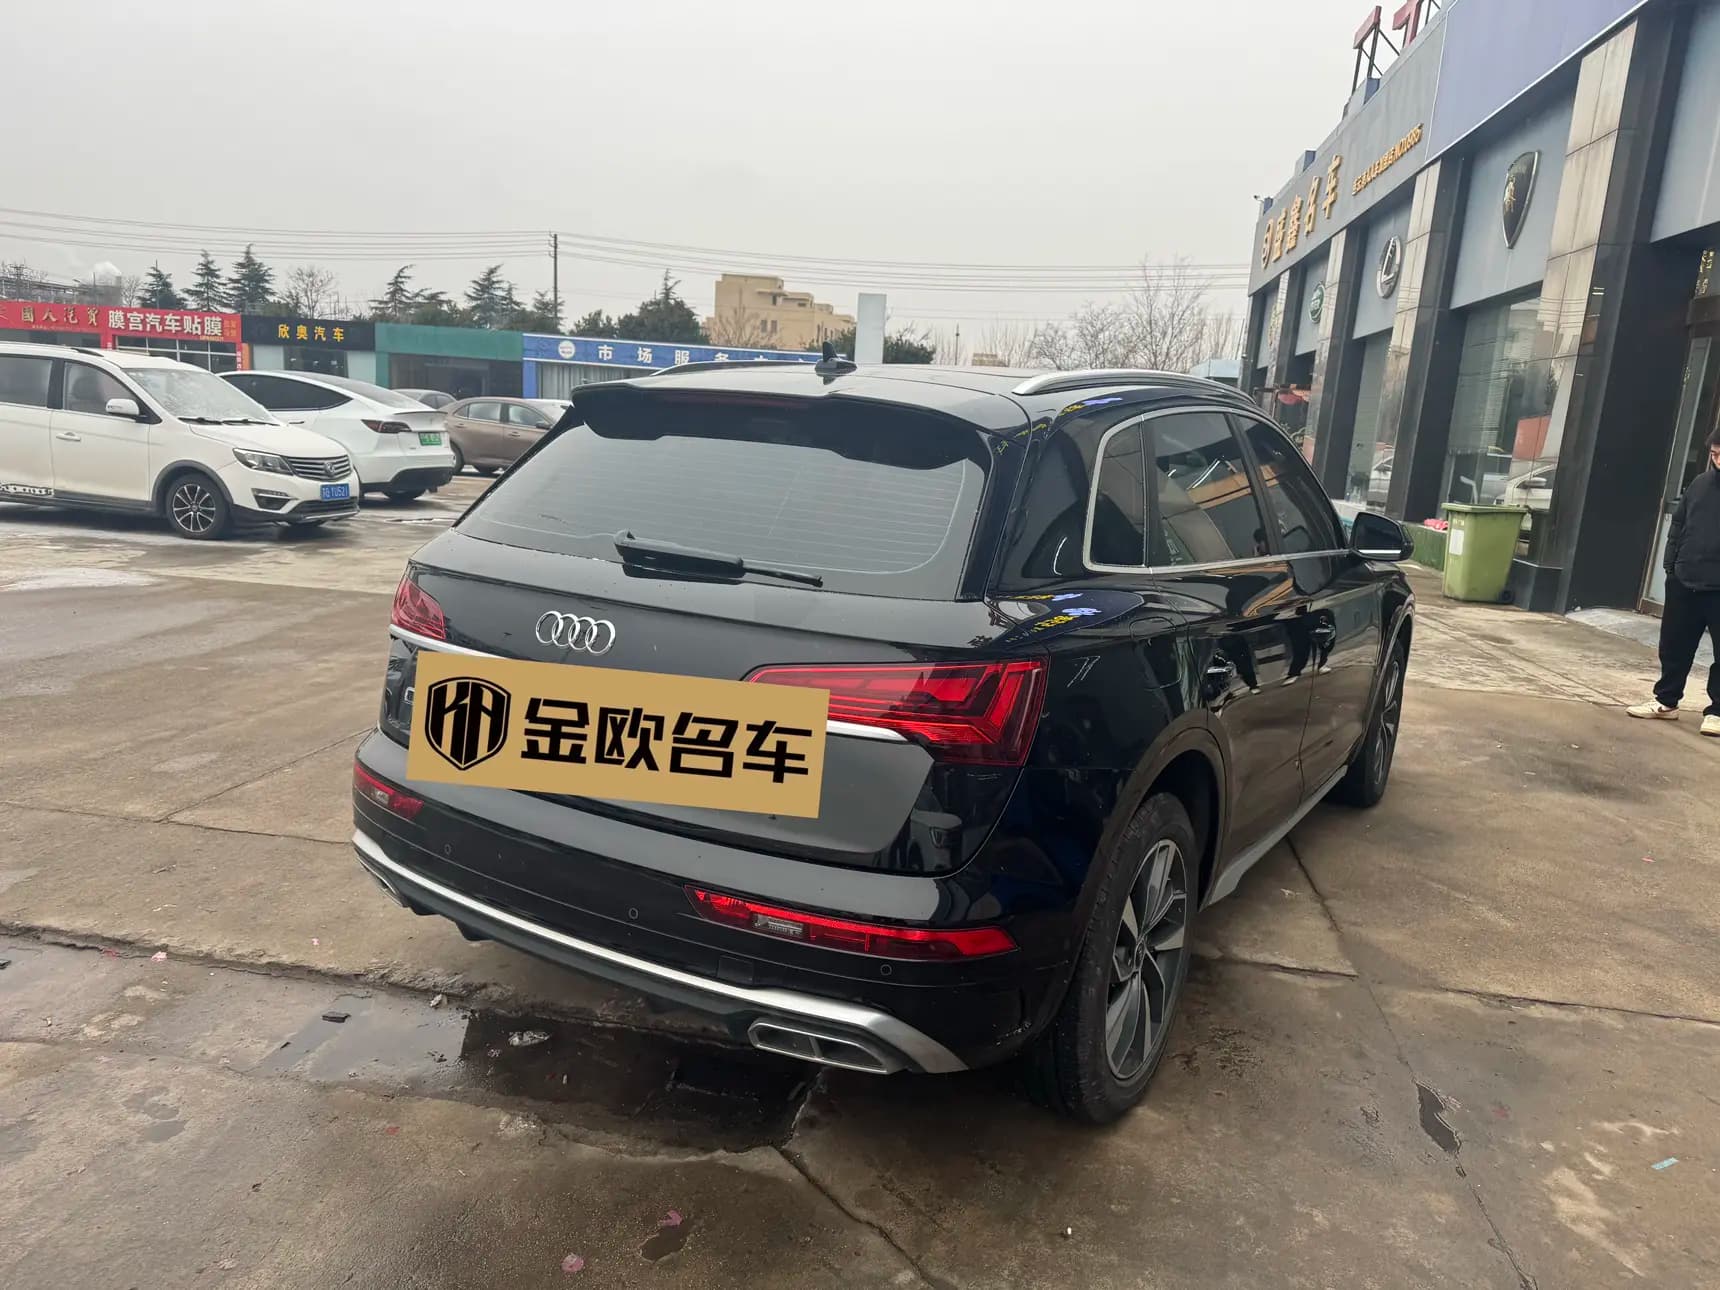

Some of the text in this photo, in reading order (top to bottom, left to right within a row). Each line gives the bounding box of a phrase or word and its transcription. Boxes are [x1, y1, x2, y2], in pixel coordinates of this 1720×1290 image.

[108, 310, 222, 336] 膜宫汽车贴膜
[277, 323, 344, 342] 欣奥汽车
